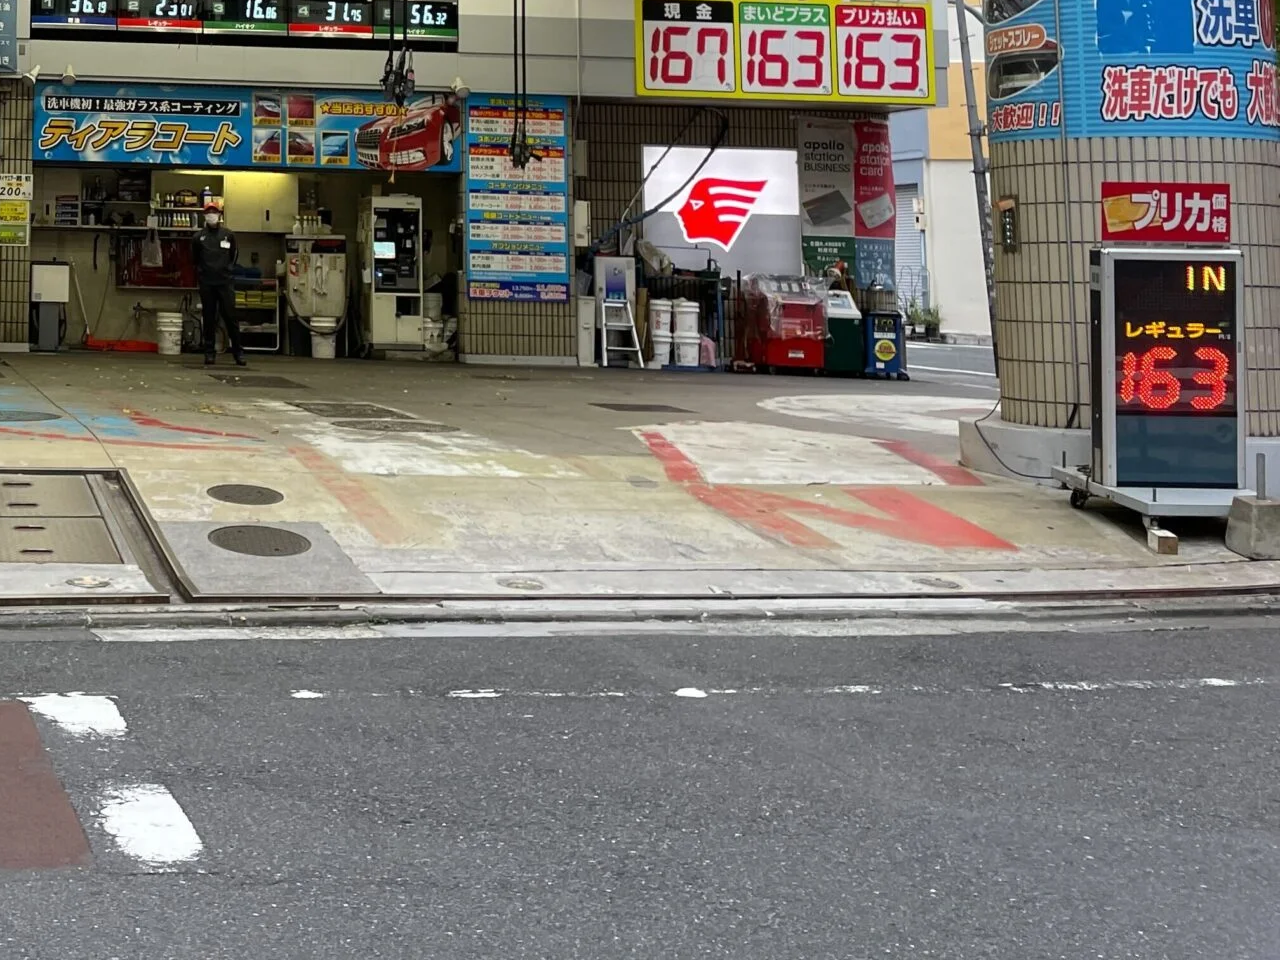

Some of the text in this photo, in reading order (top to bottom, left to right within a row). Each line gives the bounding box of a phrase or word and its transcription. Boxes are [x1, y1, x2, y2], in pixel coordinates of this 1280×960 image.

[664, 2, 713, 20] 現金
[743, 5, 827, 25] まいどプラス
[842, 8, 918, 27] プリカ払い
[649, 26, 728, 84] 167
[746, 29, 825, 87] 163
[845, 33, 920, 90] 163
[1102, 64, 1239, 121] 洗車だけでも
[39, 118, 242, 155] ティアラコート
[803, 140, 845, 151] apollo
[804, 152, 845, 162] station
[804, 162, 851, 173] BUSINESS
[860, 167, 884, 177] card
[1131, 190, 1211, 232] プリカ
[1185, 265, 1226, 291] IN
[1125, 322, 1222, 339] レギュラー
[1120, 346, 1229, 410] 163
